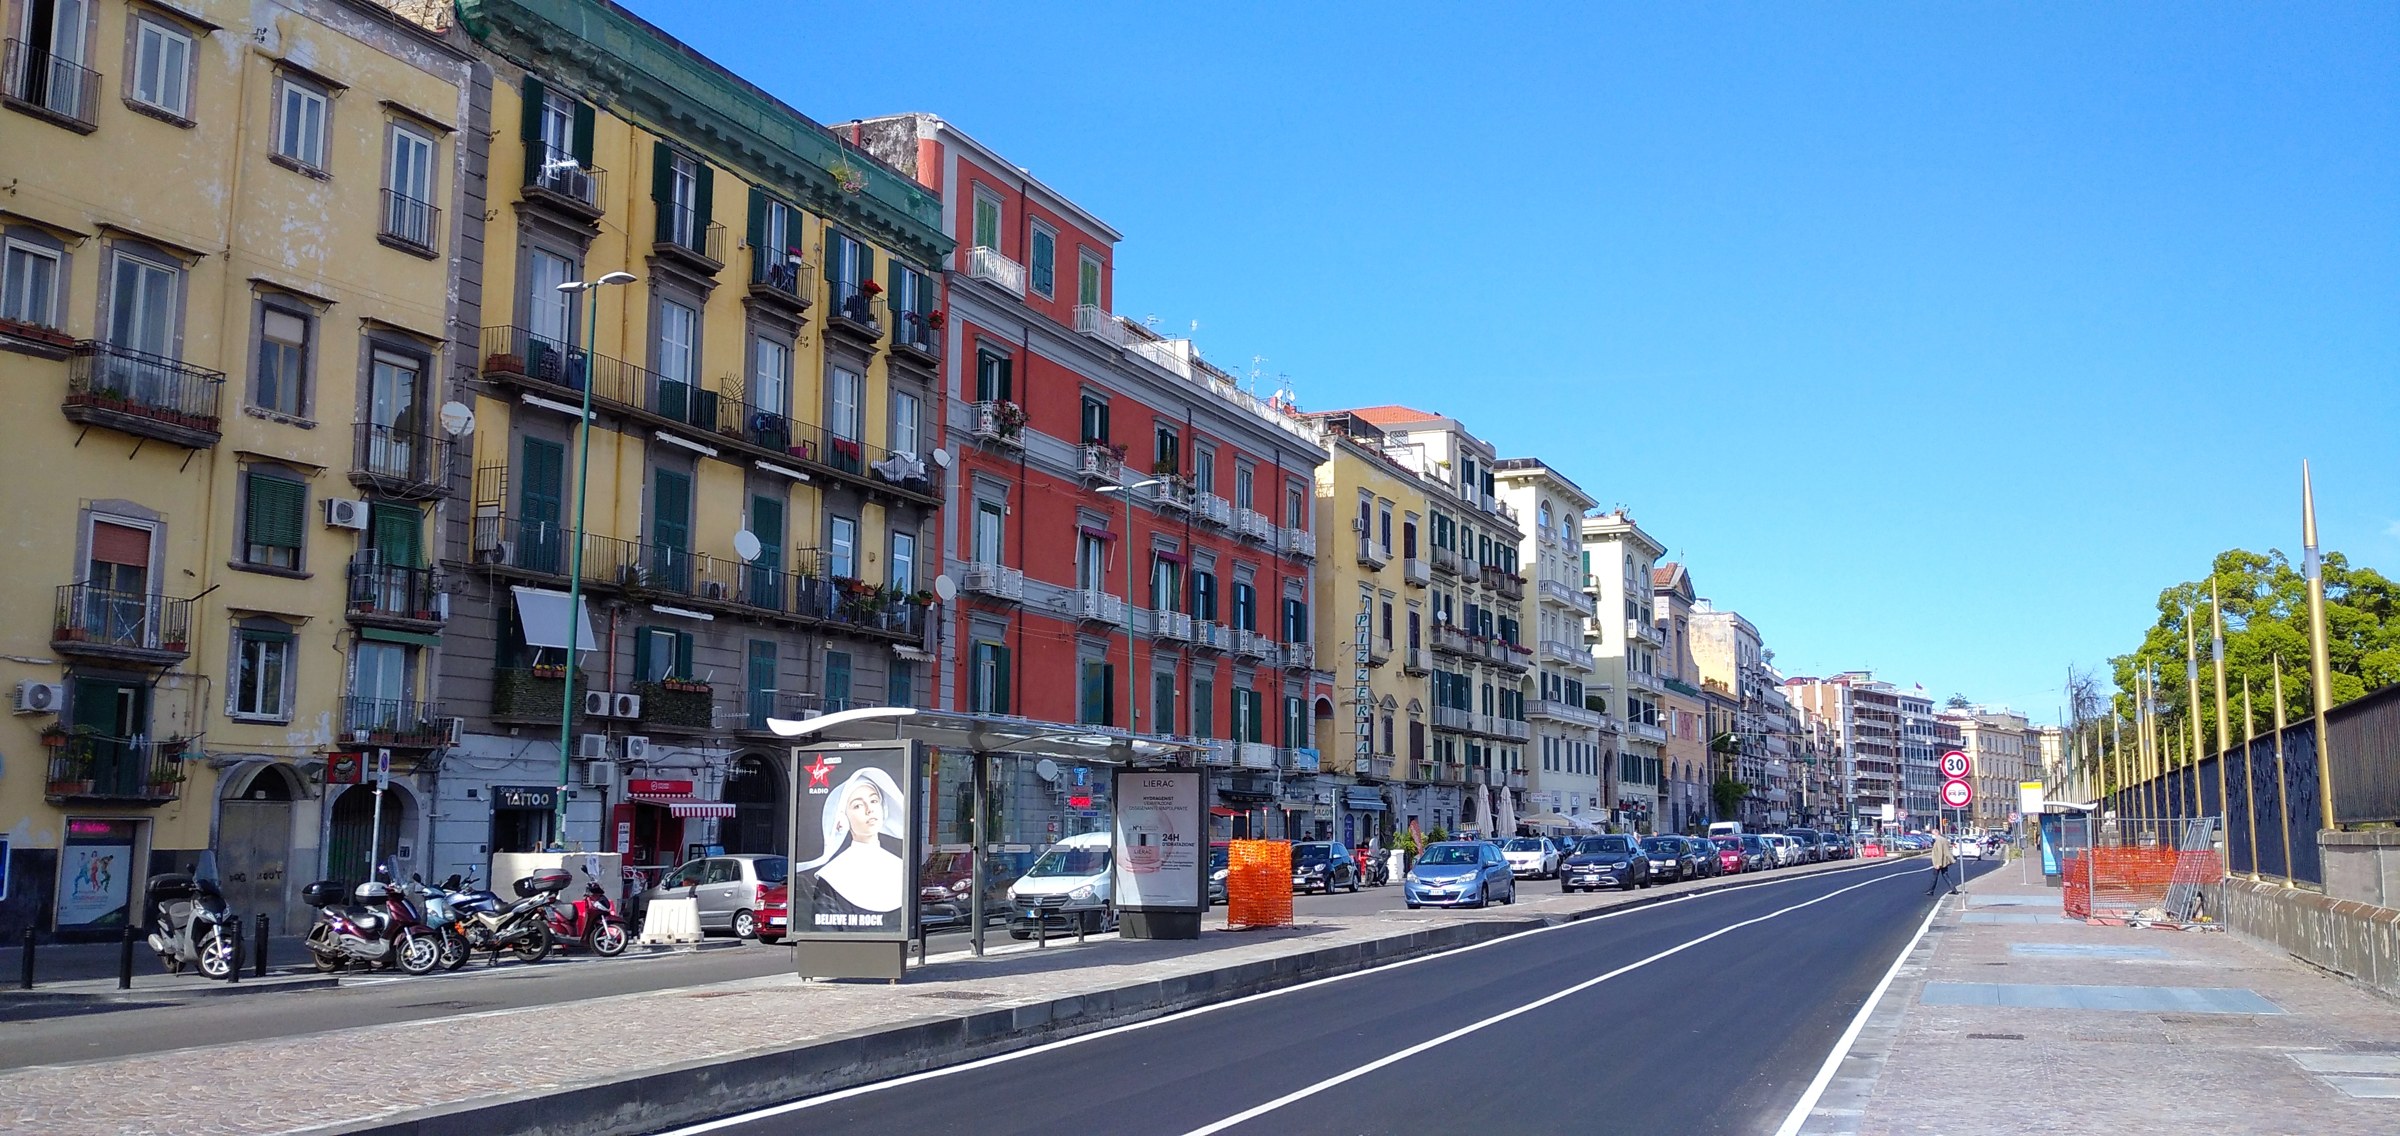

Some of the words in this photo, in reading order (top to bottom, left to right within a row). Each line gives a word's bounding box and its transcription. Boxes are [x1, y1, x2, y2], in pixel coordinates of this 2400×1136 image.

[1357, 614, 1368, 754] PIZZERIA
[1947, 758, 1964, 771] 30
[1143, 780, 1174, 788] LIERAC
[505, 793, 549, 806] TATTOO
[1162, 833, 1180, 842] 24H
[814, 913, 847, 926] BELIEVE
[848, 914, 857, 926] IN
[858, 914, 883, 926] ROCK
